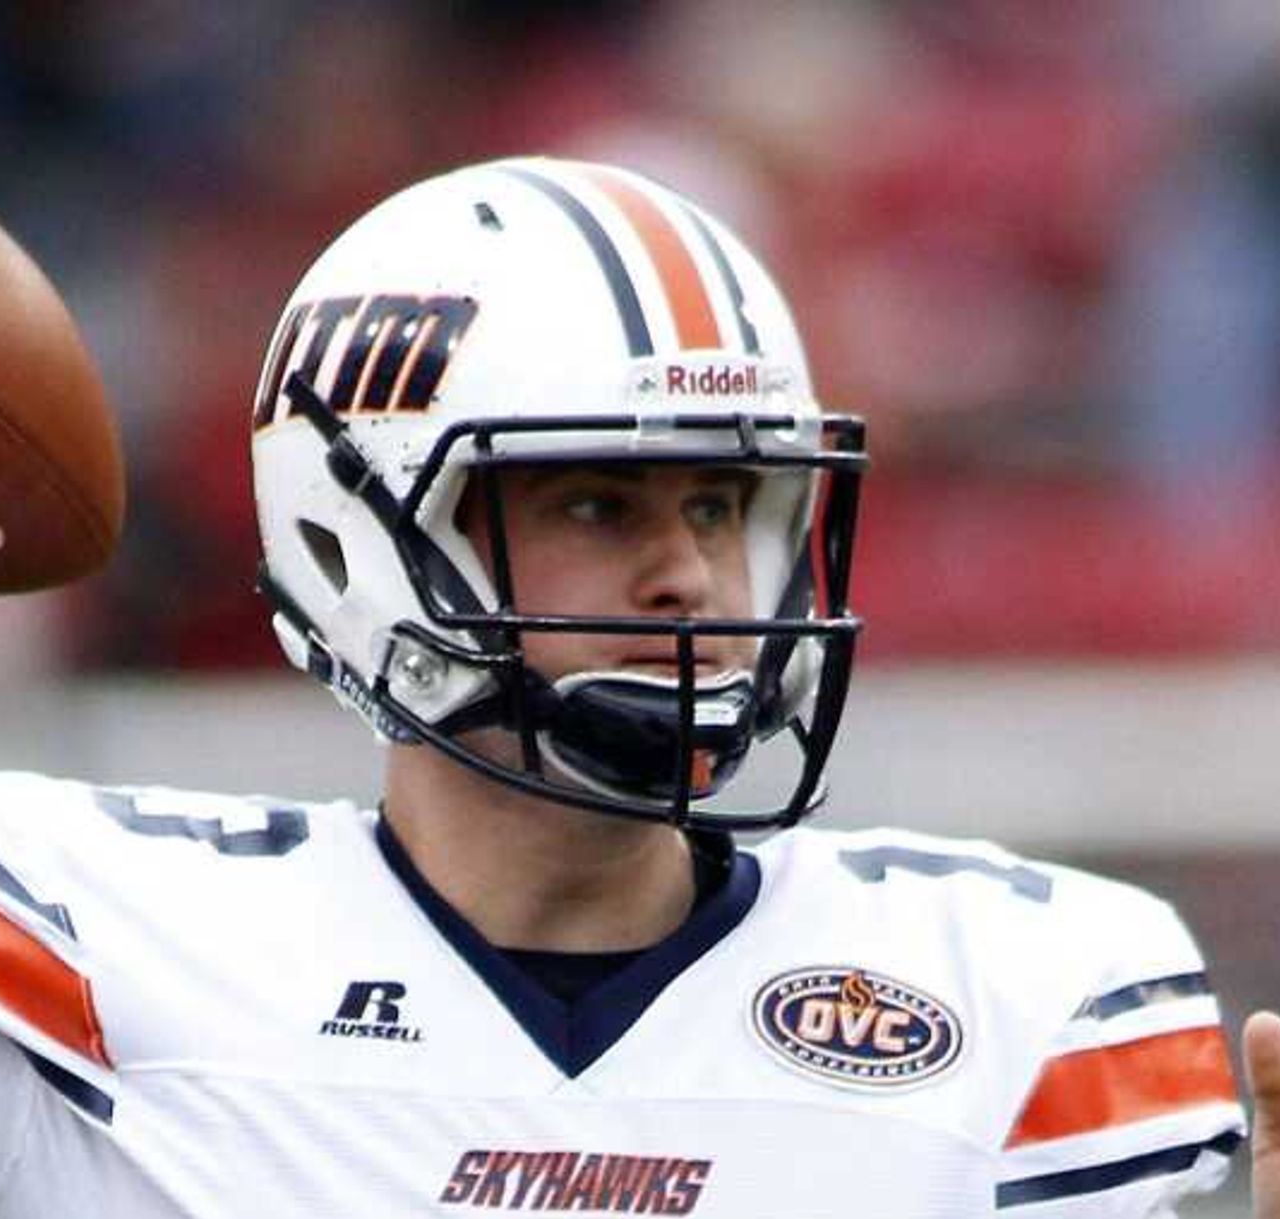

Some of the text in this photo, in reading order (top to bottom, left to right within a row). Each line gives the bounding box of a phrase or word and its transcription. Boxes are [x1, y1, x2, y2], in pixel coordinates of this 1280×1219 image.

[666, 364, 758, 396] Riddell
[335, 980, 407, 1024] R
[319, 1020, 424, 1042] RUSSELL
[796, 998, 911, 1054] OVC
[438, 1149, 713, 1217] SKYHAWKS
